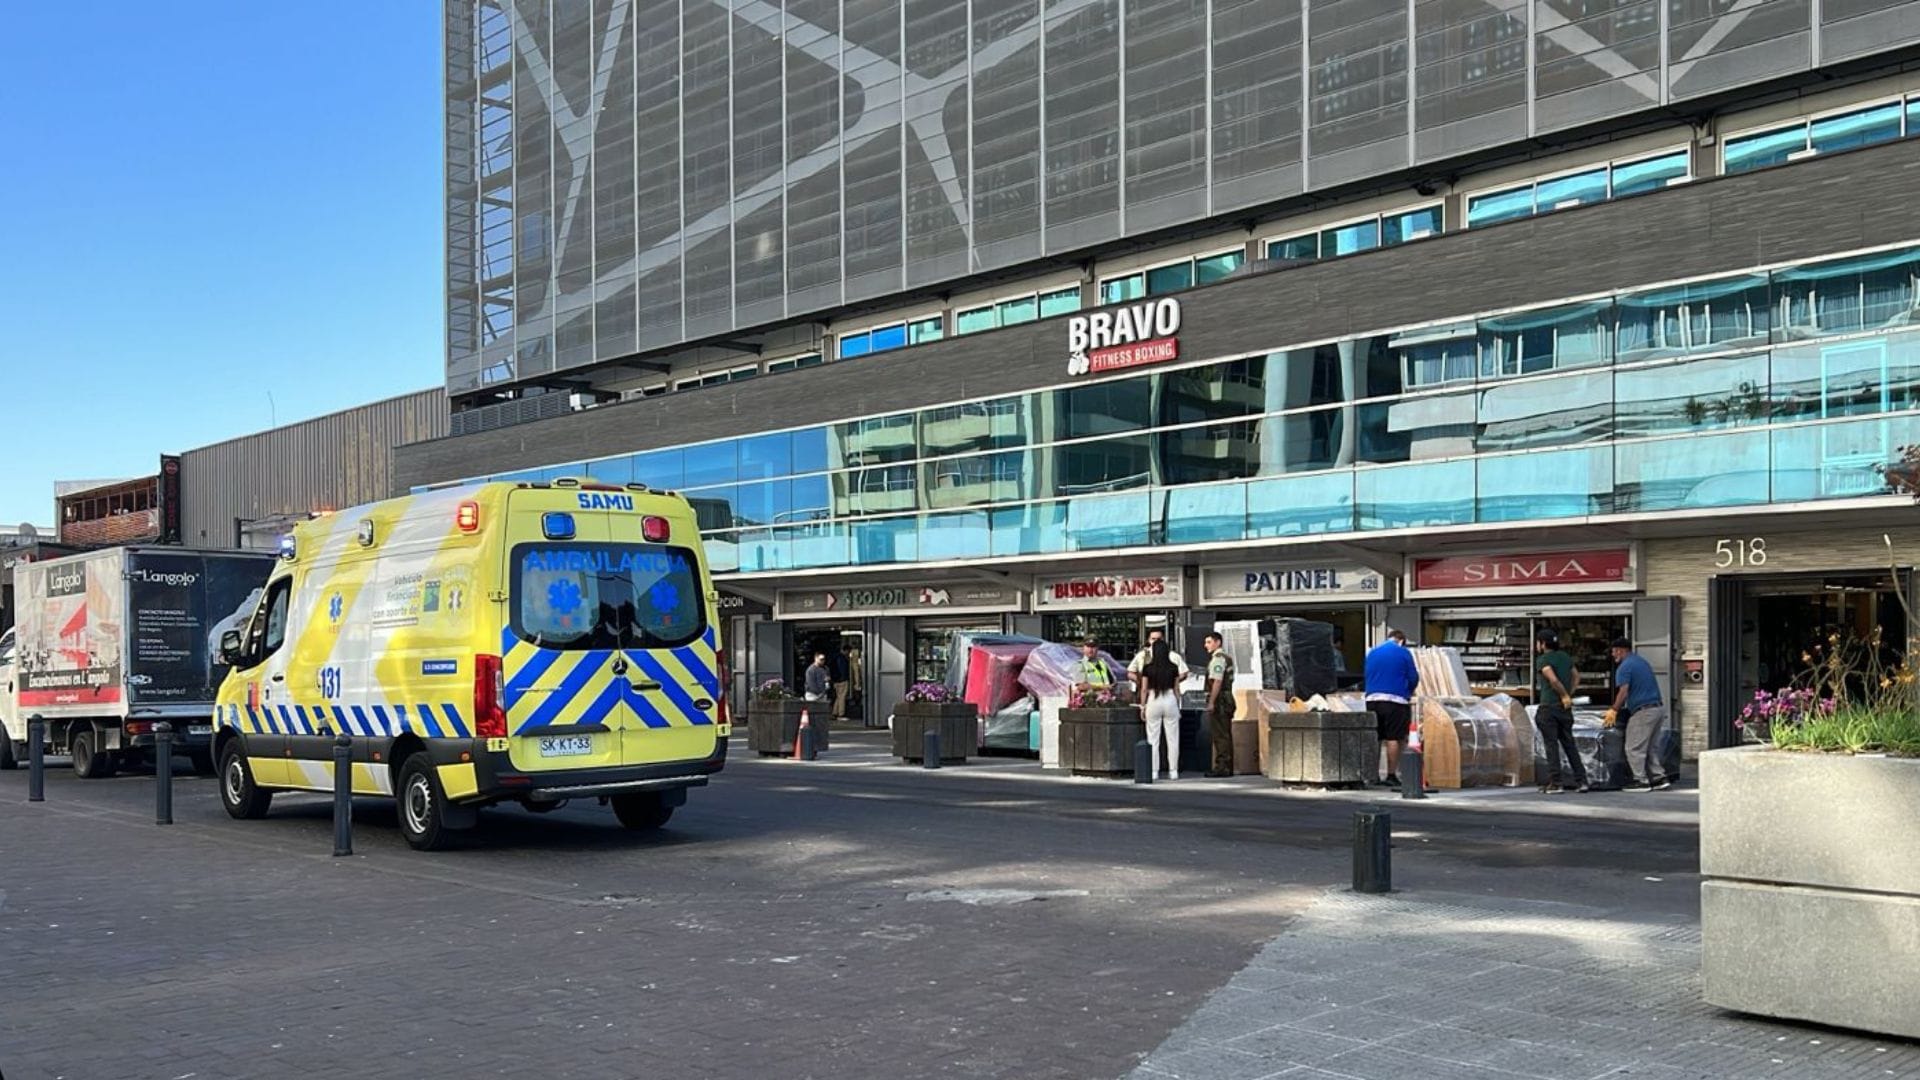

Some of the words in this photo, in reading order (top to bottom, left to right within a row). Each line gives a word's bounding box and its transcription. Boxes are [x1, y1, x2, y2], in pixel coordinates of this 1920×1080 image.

[1069, 298, 1180, 352] BRAVO
[1093, 350, 1132, 368] FITNESS
[1135, 343, 1173, 361] BOXING
[577, 493, 634, 511] SAMU
[527, 550, 689, 573] AMBULANCIA
[1715, 537, 1766, 567] 518
[1244, 569, 1341, 592] PATINEL
[1463, 559, 1590, 582] SIMA
[1054, 580, 1116, 599] BUENOS
[1120, 579, 1165, 596] AIRES
[322, 668, 341, 698] 131
